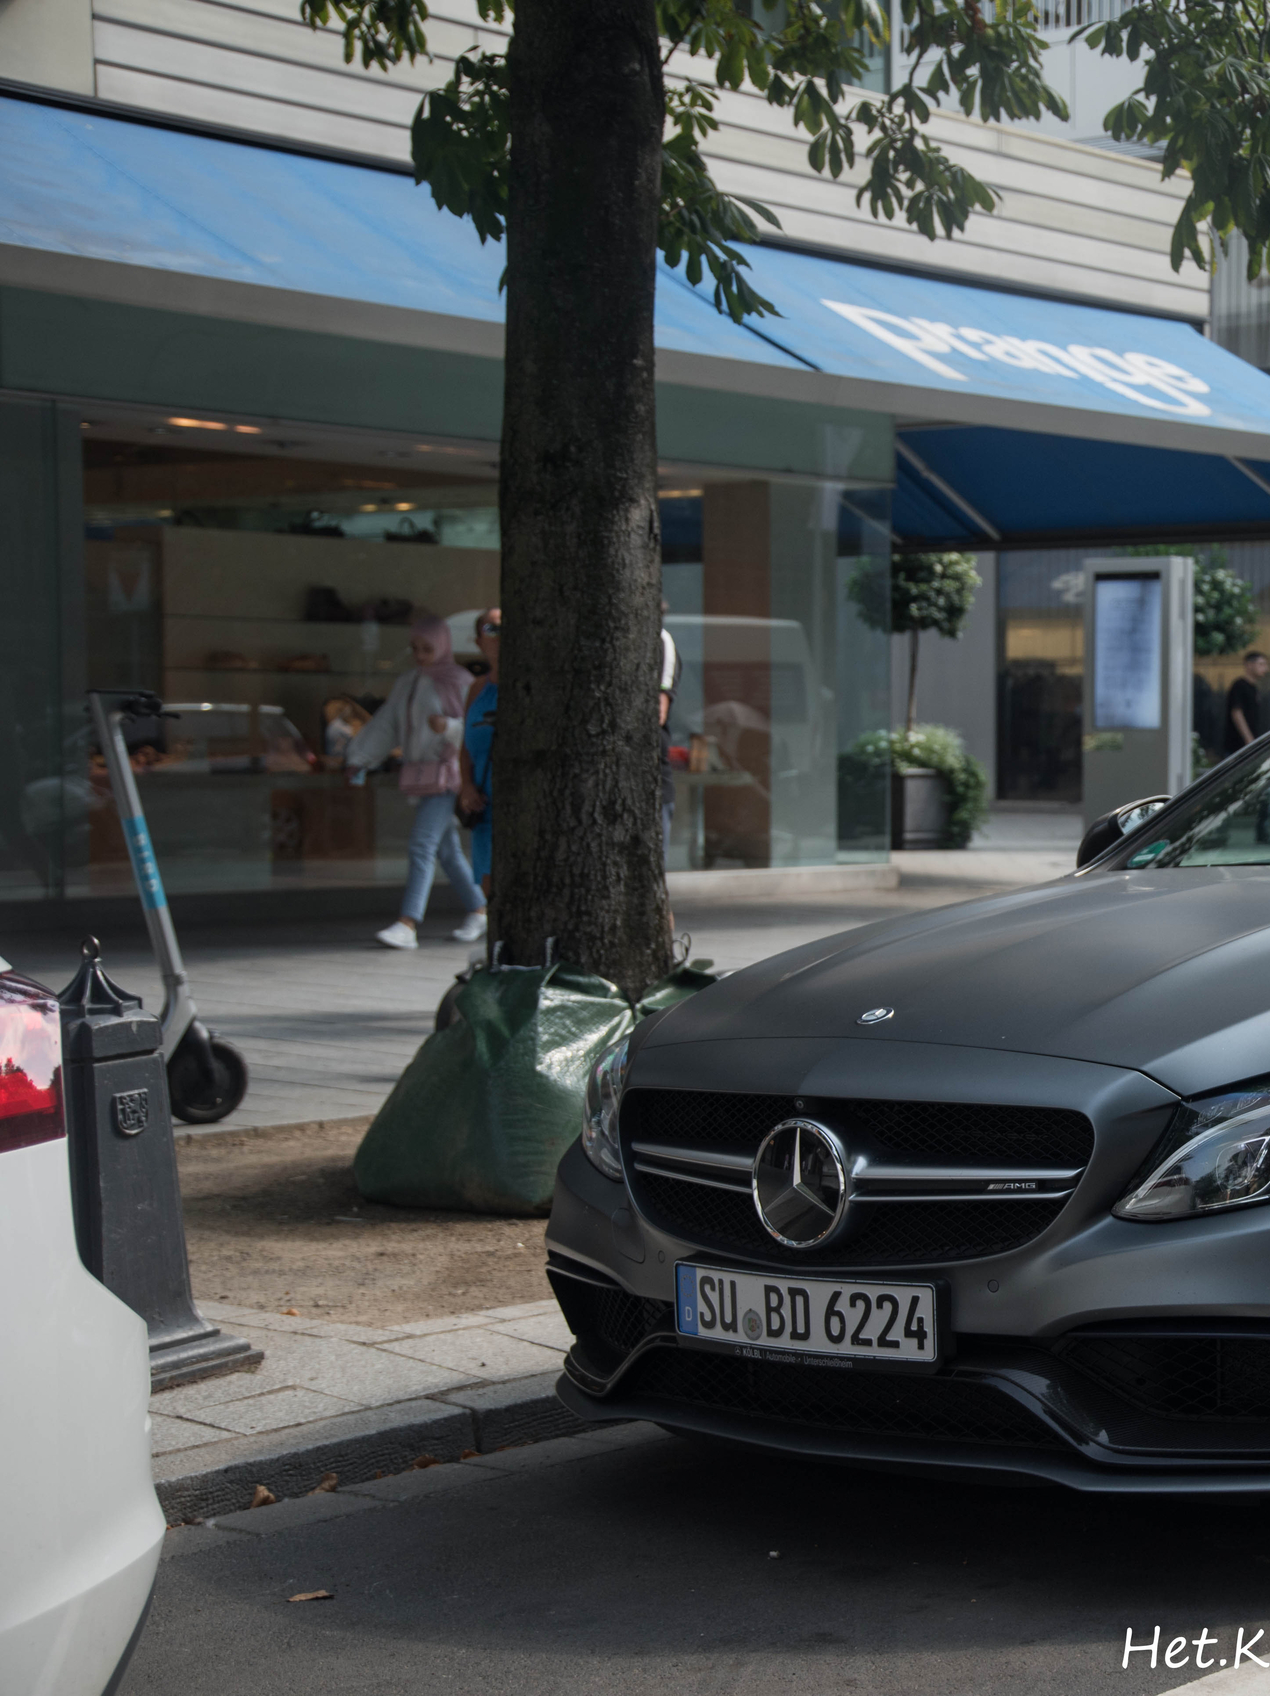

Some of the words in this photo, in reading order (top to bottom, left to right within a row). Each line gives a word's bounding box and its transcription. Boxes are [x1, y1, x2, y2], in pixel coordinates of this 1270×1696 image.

[820, 298, 1212, 417] prange
[1003, 1182, 1037, 1190] AMG
[684, 1306, 693, 1322] D
[699, 1275, 738, 1334] SU
[764, 1284, 811, 1341] BD
[823, 1290, 928, 1350] 6224
[743, 1346, 762, 1359] KÖLBL
[766, 1351, 796, 1364] Automobile
